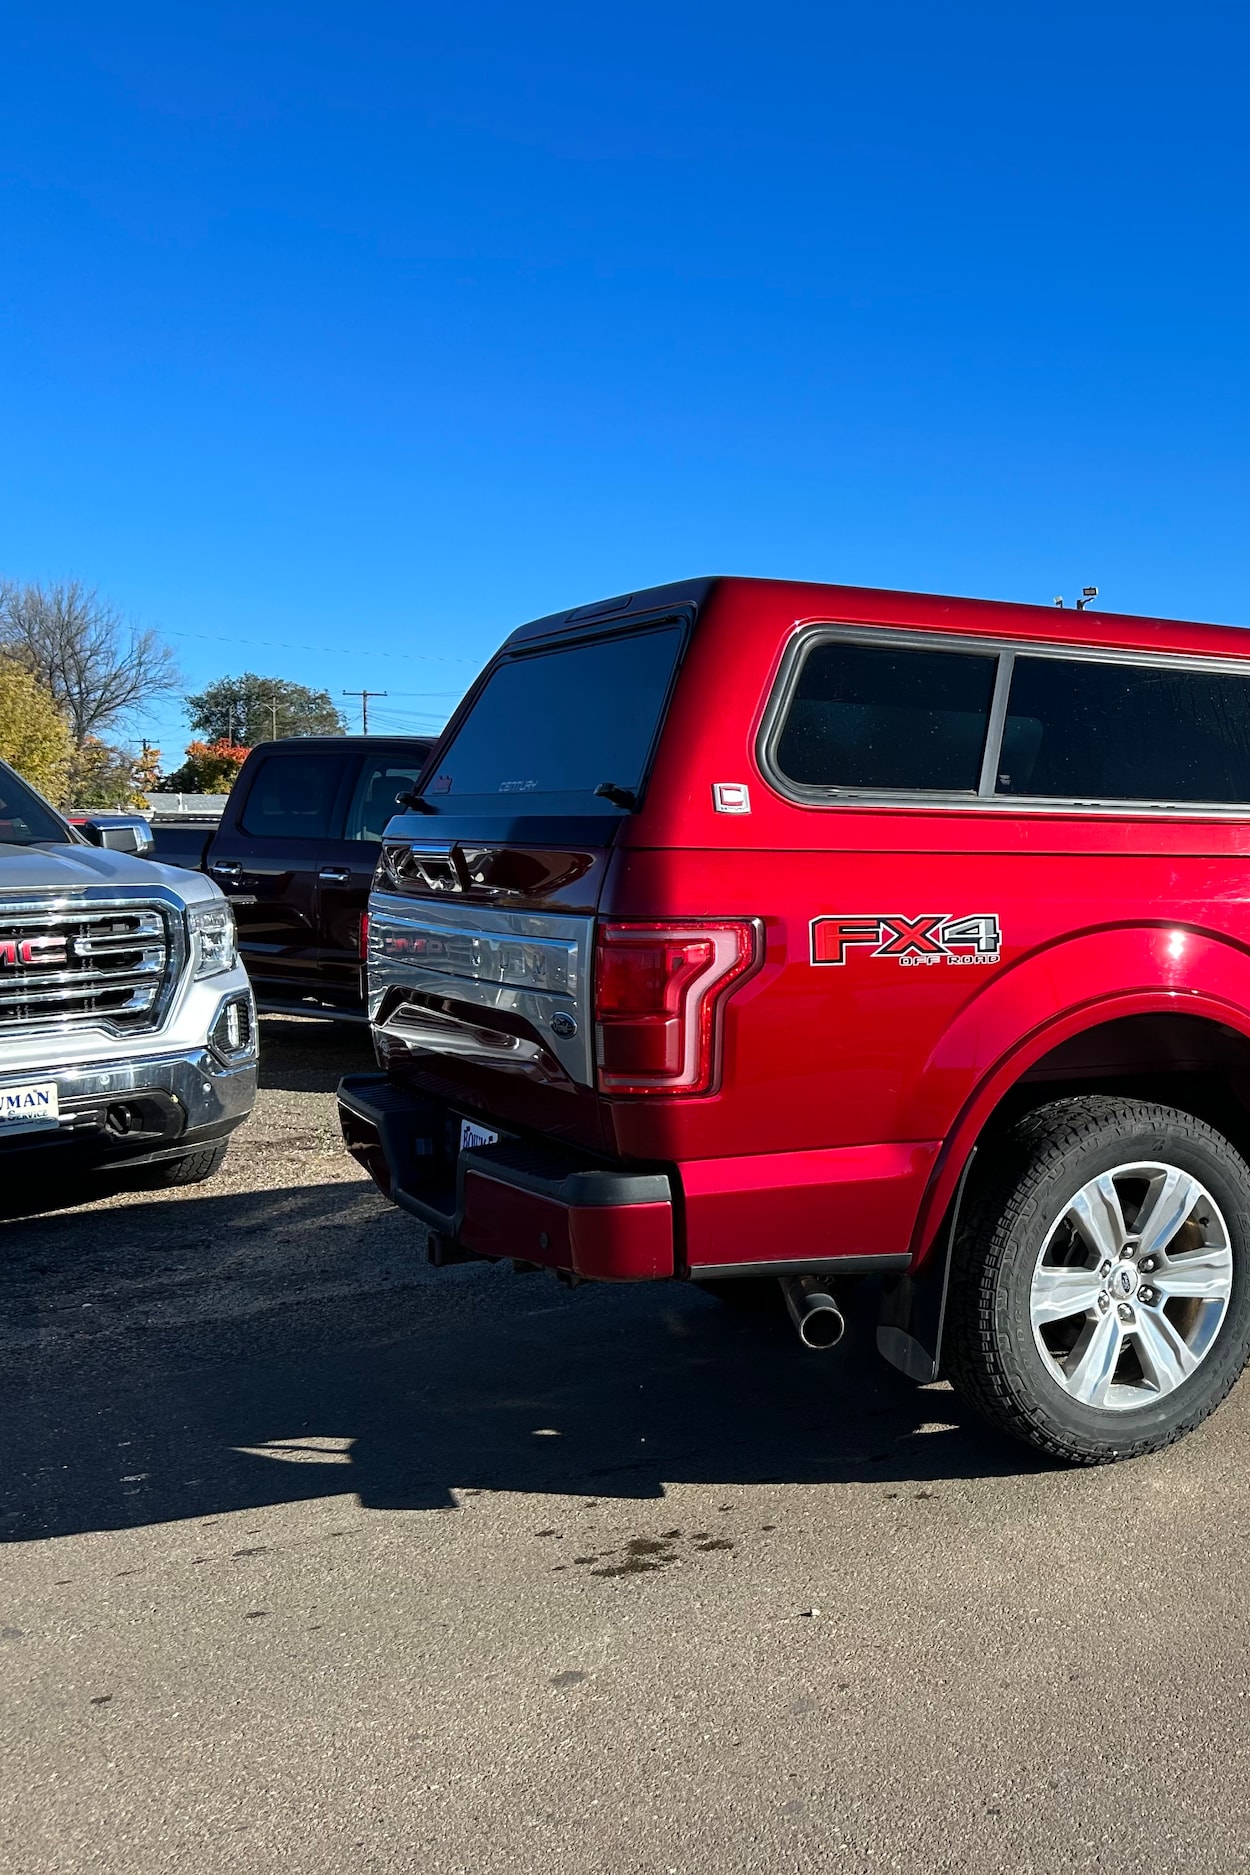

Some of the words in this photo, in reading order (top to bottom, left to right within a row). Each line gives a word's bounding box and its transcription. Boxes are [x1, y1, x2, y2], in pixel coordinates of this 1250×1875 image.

[809, 914, 1002, 966] FX4
[899, 956, 941, 966] OFF
[947, 954, 1000, 965] ROAD
